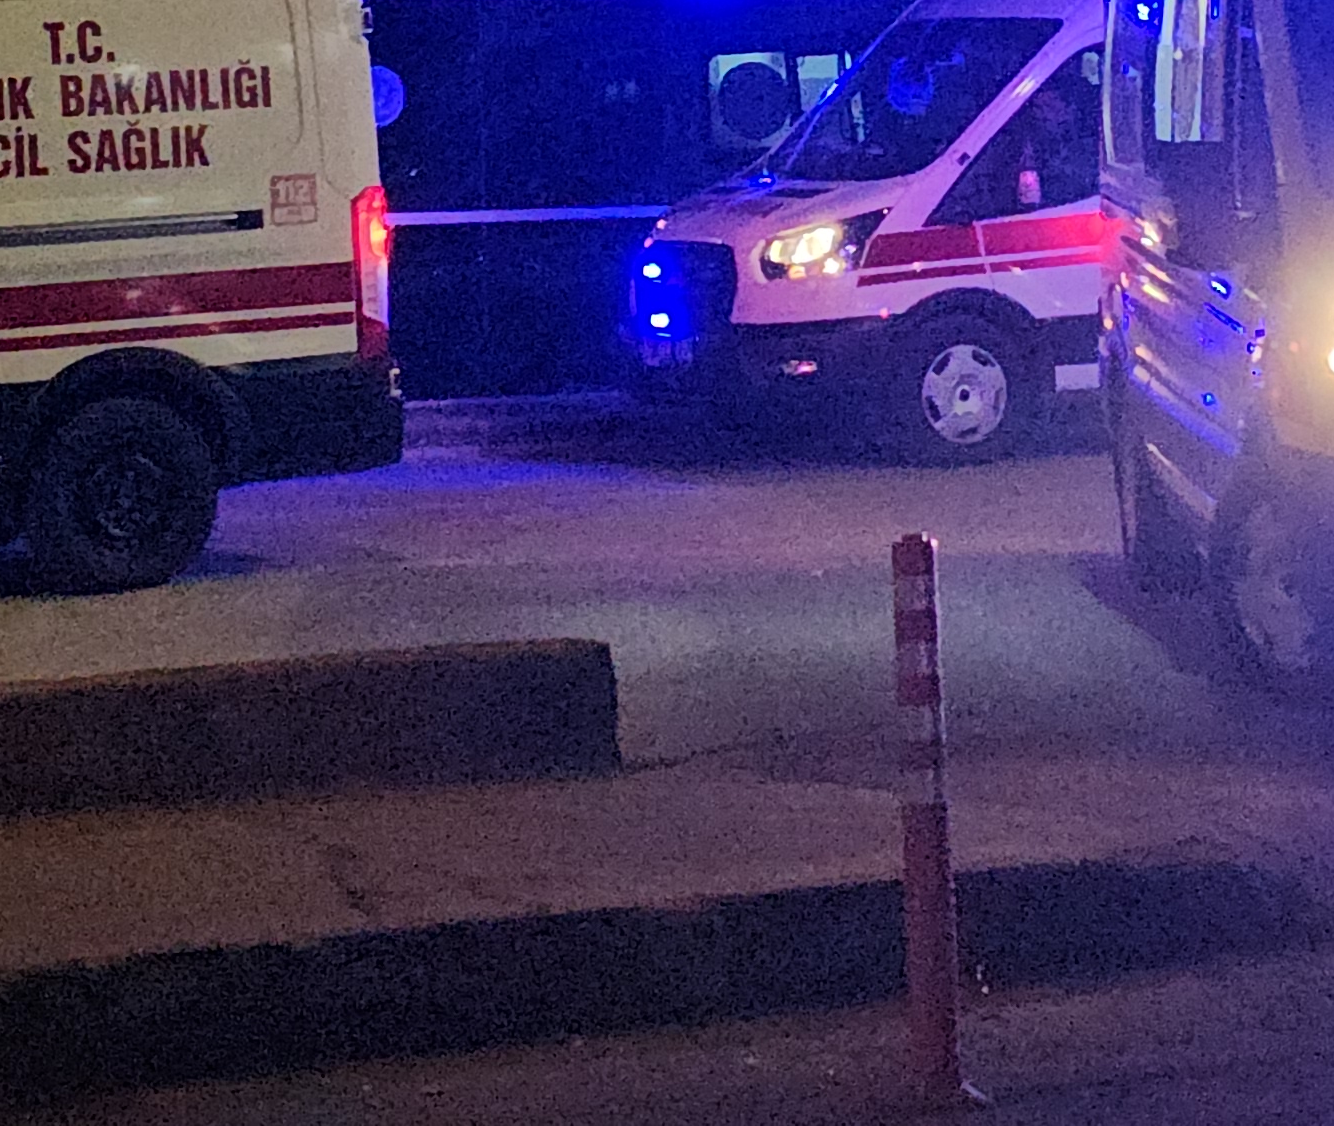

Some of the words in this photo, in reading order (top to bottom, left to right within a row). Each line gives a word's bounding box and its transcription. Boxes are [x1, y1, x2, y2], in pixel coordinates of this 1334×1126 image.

[43, 20, 115, 65] T.C.
[60, 59, 272, 117] BAKANLIĞI
[67, 120, 210, 174] SAĞLIK
